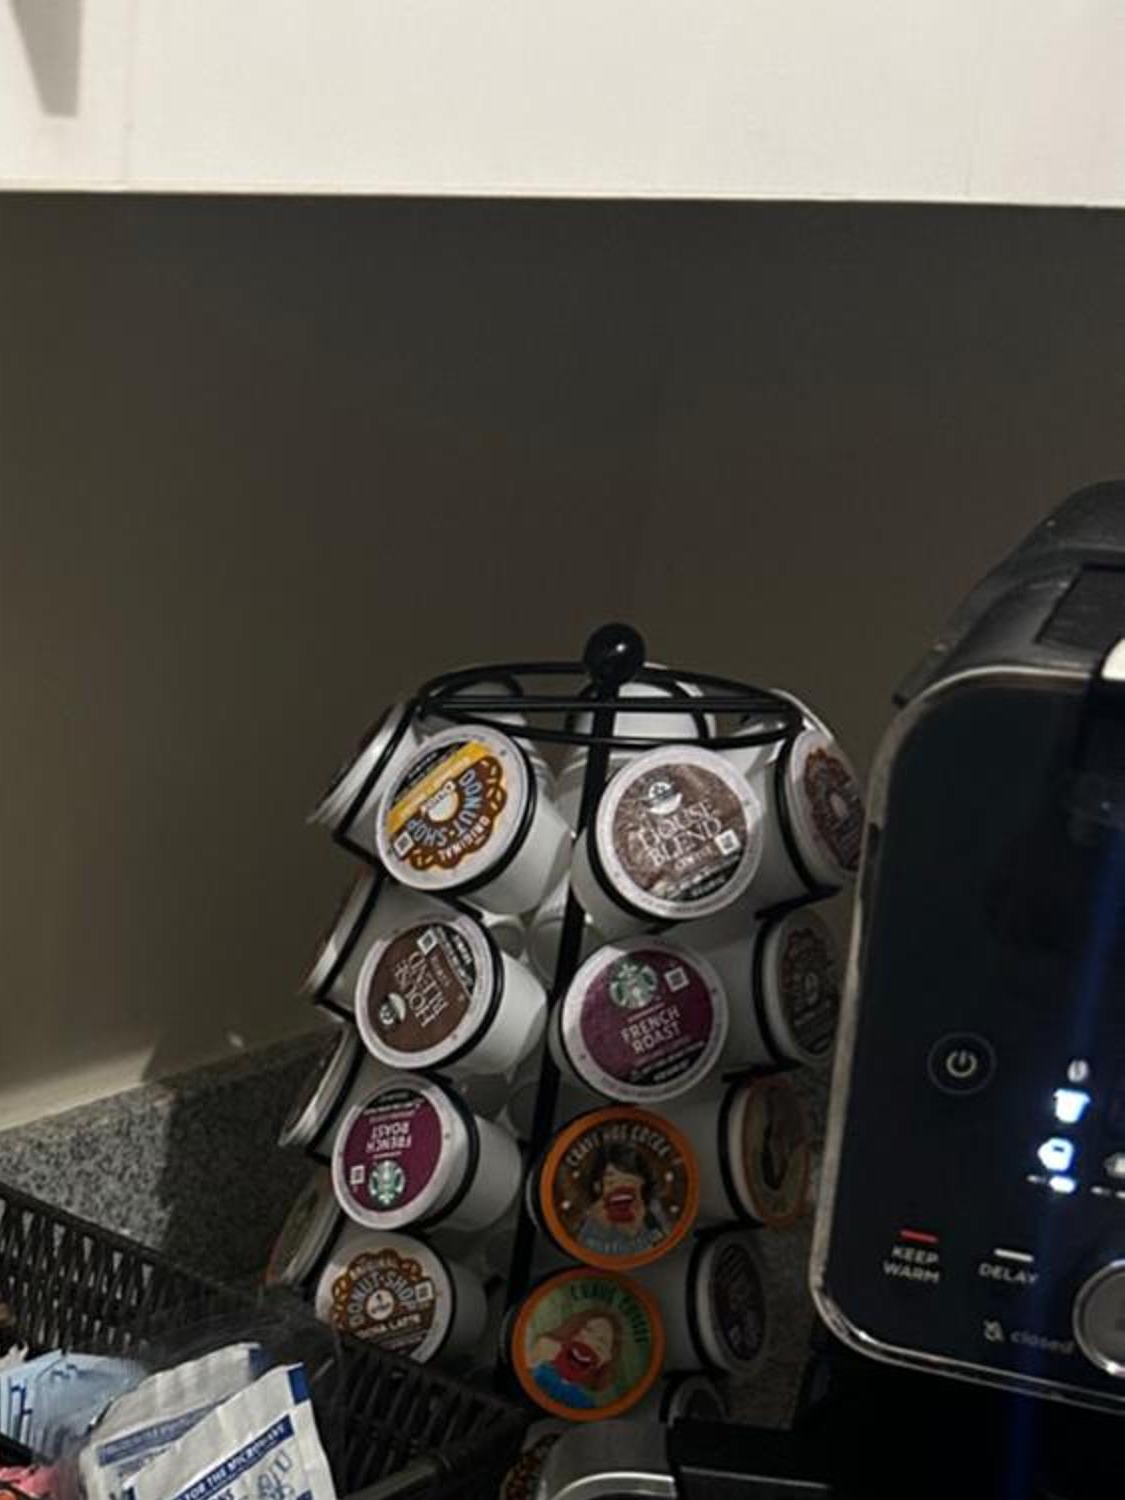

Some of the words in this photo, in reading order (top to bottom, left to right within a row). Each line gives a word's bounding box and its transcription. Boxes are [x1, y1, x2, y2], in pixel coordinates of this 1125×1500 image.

[453, 768, 484, 839] DONUT
[407, 819, 447, 847] SHOP
[636, 802, 713, 851] HOUSE
[648, 816, 722, 867] BLEND
[389, 958, 438, 1028] HOUSE
[621, 1006, 681, 1042] FRENCH
[632, 1022, 681, 1055] ROAST
[372, 1121, 411, 1139] ROAST
[366, 1134, 412, 1154] FRENCH
[892, 1246, 939, 1264] KEEP
[883, 1261, 940, 1283] WARM
[978, 1263, 1038, 1284] DELAY
[1010, 1330, 1075, 1354] closed
[206, 1469, 228, 1490] THE
